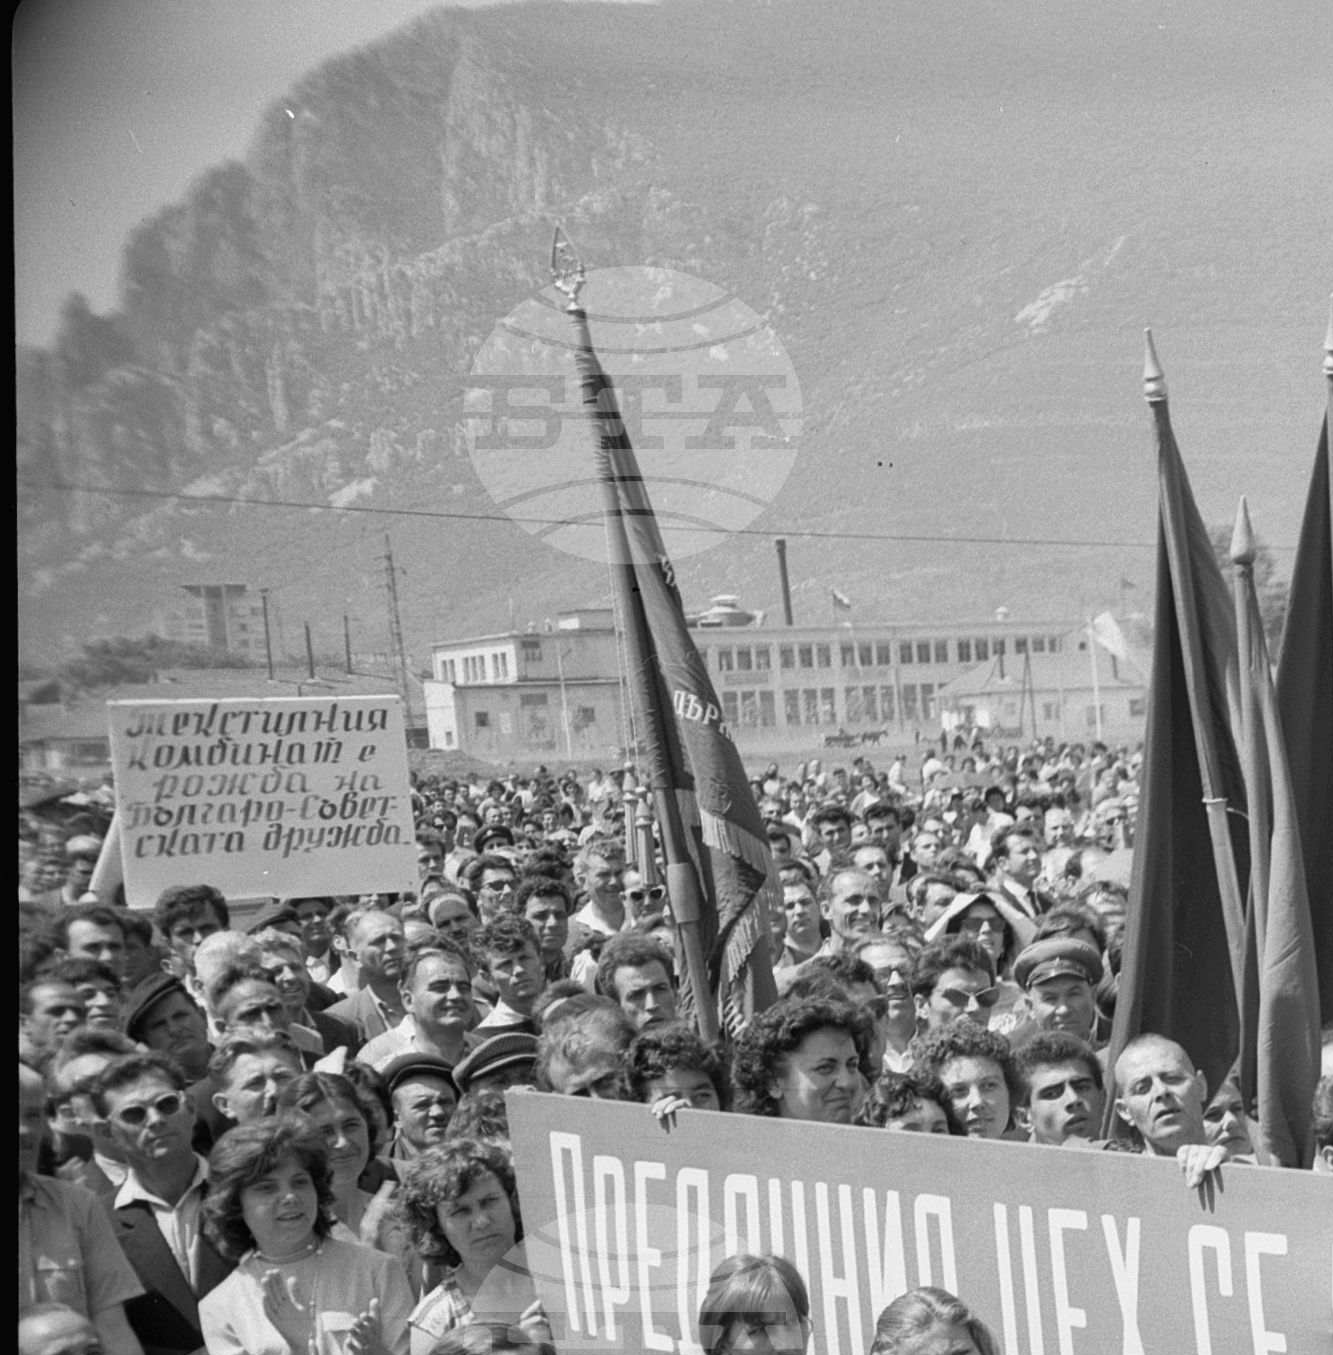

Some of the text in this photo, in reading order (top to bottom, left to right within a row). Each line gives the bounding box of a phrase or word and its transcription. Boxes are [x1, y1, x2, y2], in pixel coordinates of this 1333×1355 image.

[152, 765, 387, 804] рожба на
[134, 827, 245, 859] ската
